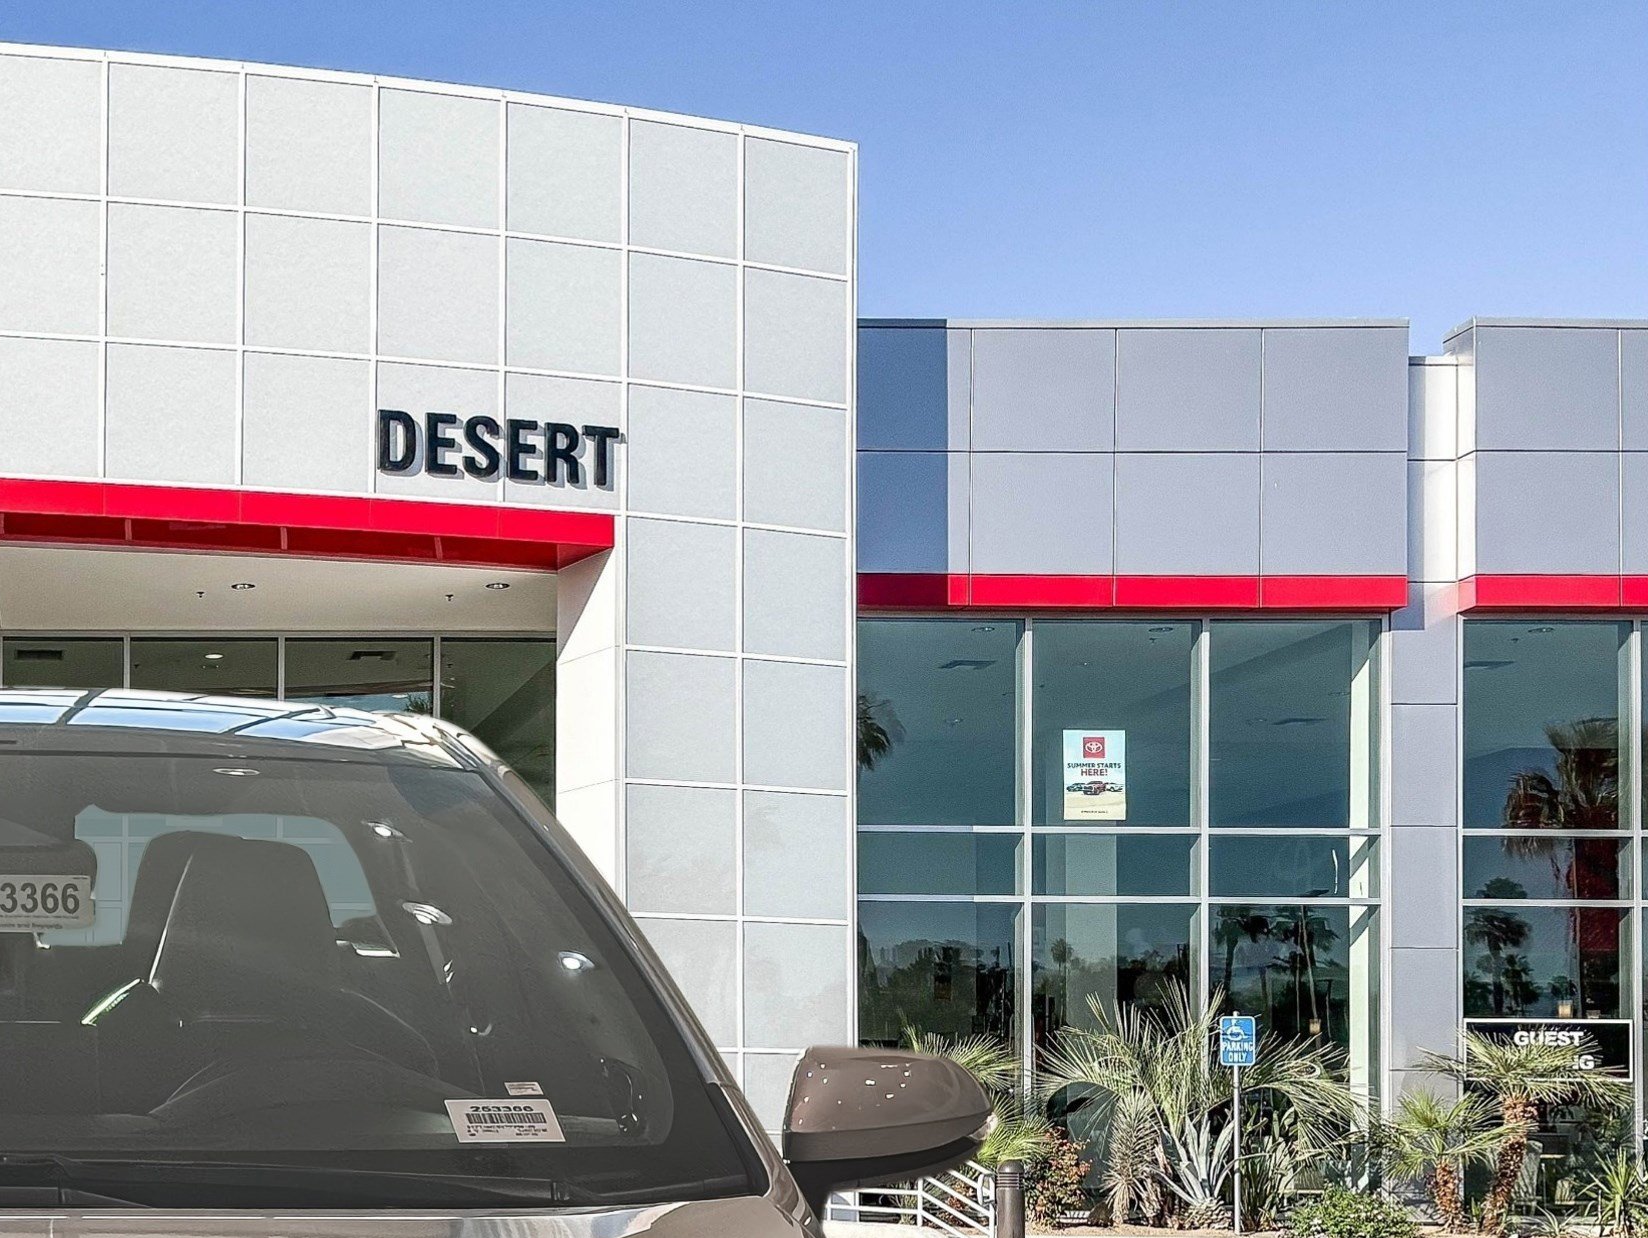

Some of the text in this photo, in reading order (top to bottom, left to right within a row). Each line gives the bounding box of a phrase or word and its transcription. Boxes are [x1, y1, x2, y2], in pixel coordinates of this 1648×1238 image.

[377, 409, 620, 487] DESERT
[1513, 1031, 1584, 1047] GUEST
[1222, 1041, 1254, 1052] PARKING
[1228, 1052, 1248, 1062] ONLY
